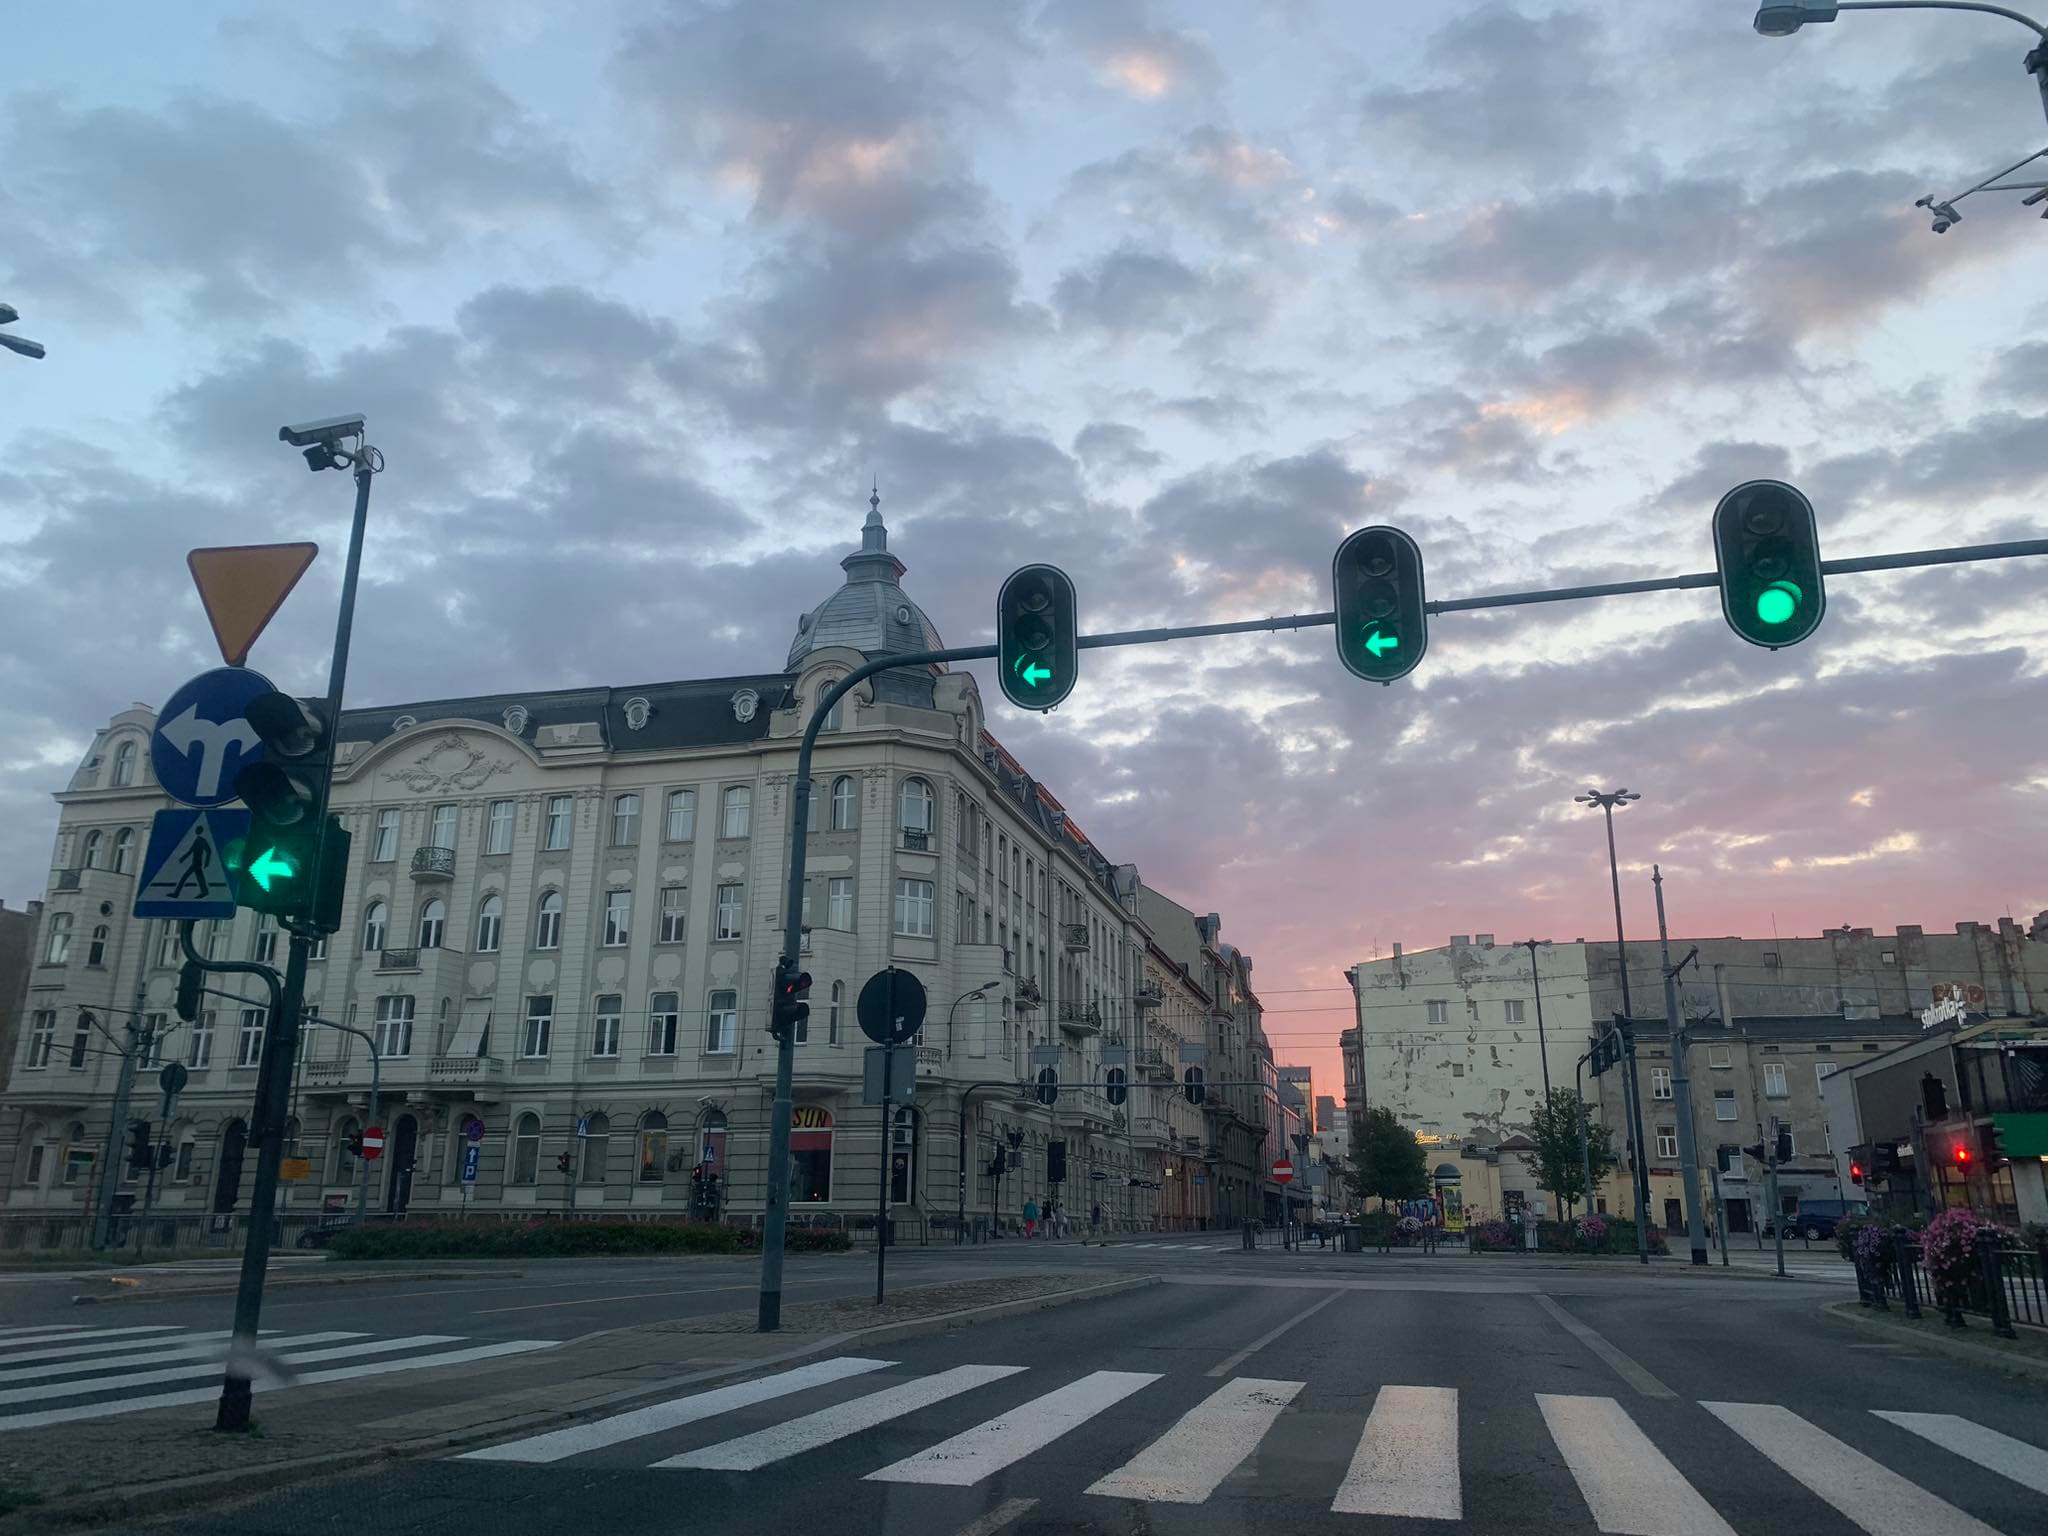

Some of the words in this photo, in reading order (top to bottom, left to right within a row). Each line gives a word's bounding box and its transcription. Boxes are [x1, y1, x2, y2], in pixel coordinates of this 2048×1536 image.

[1921, 997, 1956, 1030] stokrotka
[792, 1108, 828, 1128] SUN
[464, 1165, 475, 1179] P
